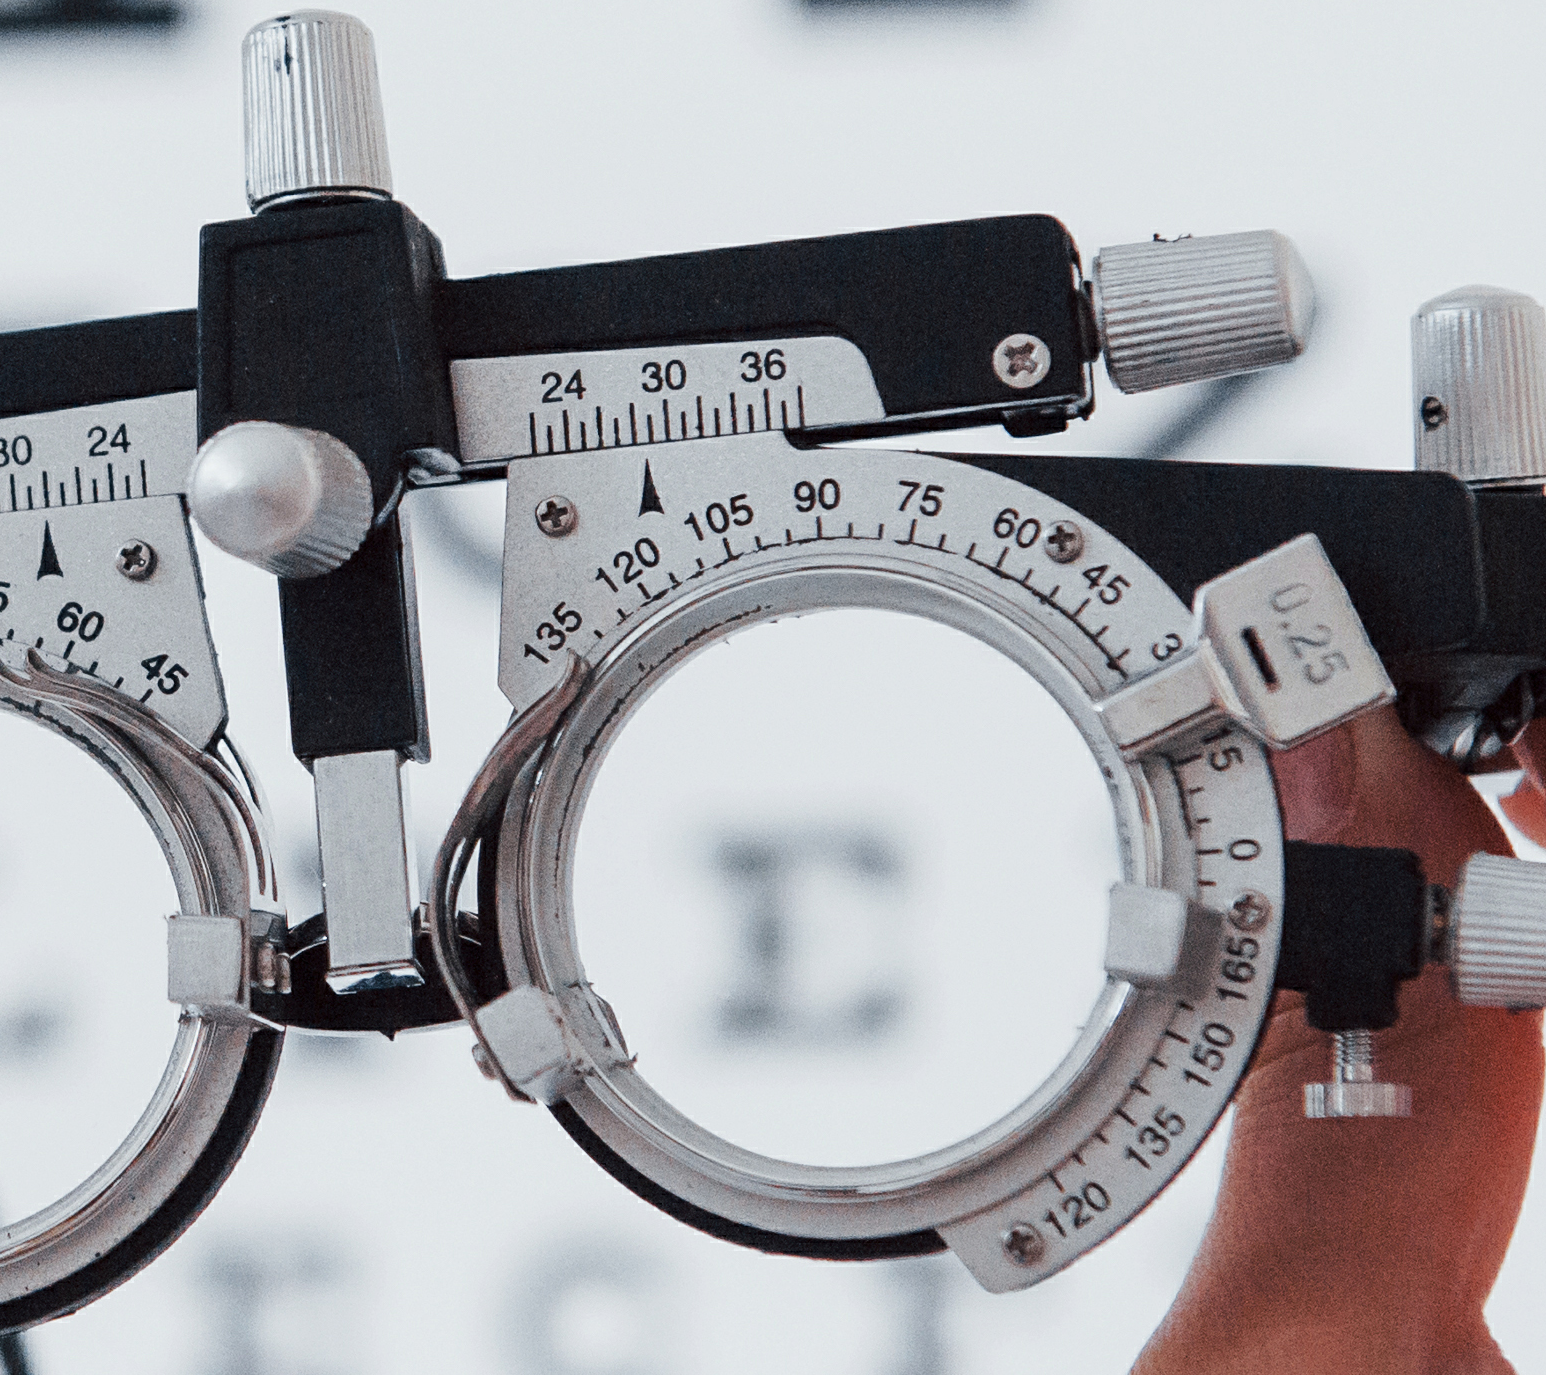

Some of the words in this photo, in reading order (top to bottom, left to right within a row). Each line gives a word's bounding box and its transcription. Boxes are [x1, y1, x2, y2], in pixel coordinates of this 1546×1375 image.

[541, 369, 587, 403] 24
[641, 359, 687, 393] 30
[740, 348, 787, 382] 36
[87, 423, 131, 457] 24
[57, 601, 105, 643] 60
[141, 653, 190, 695] 45
[523, 601, 583, 664] 135
[595, 537, 661, 592] 120
[684, 493, 754, 541] 105
[794, 478, 841, 513] 90
[898, 480, 945, 517] 75
[993, 507, 1042, 549] 60
[1082, 564, 1132, 606] 45
[1152, 633, 1183, 662] 3
[1228, 839, 1261, 861] 0
[1270, 582, 1350, 685] 0.25
[702, 828, 913, 1052] E
[1044, 1181, 1112, 1238] 120
[1125, 1106, 1187, 1170] 135
[1183, 1023, 1236, 1088] 150
[1216, 936, 1260, 1001] 165
